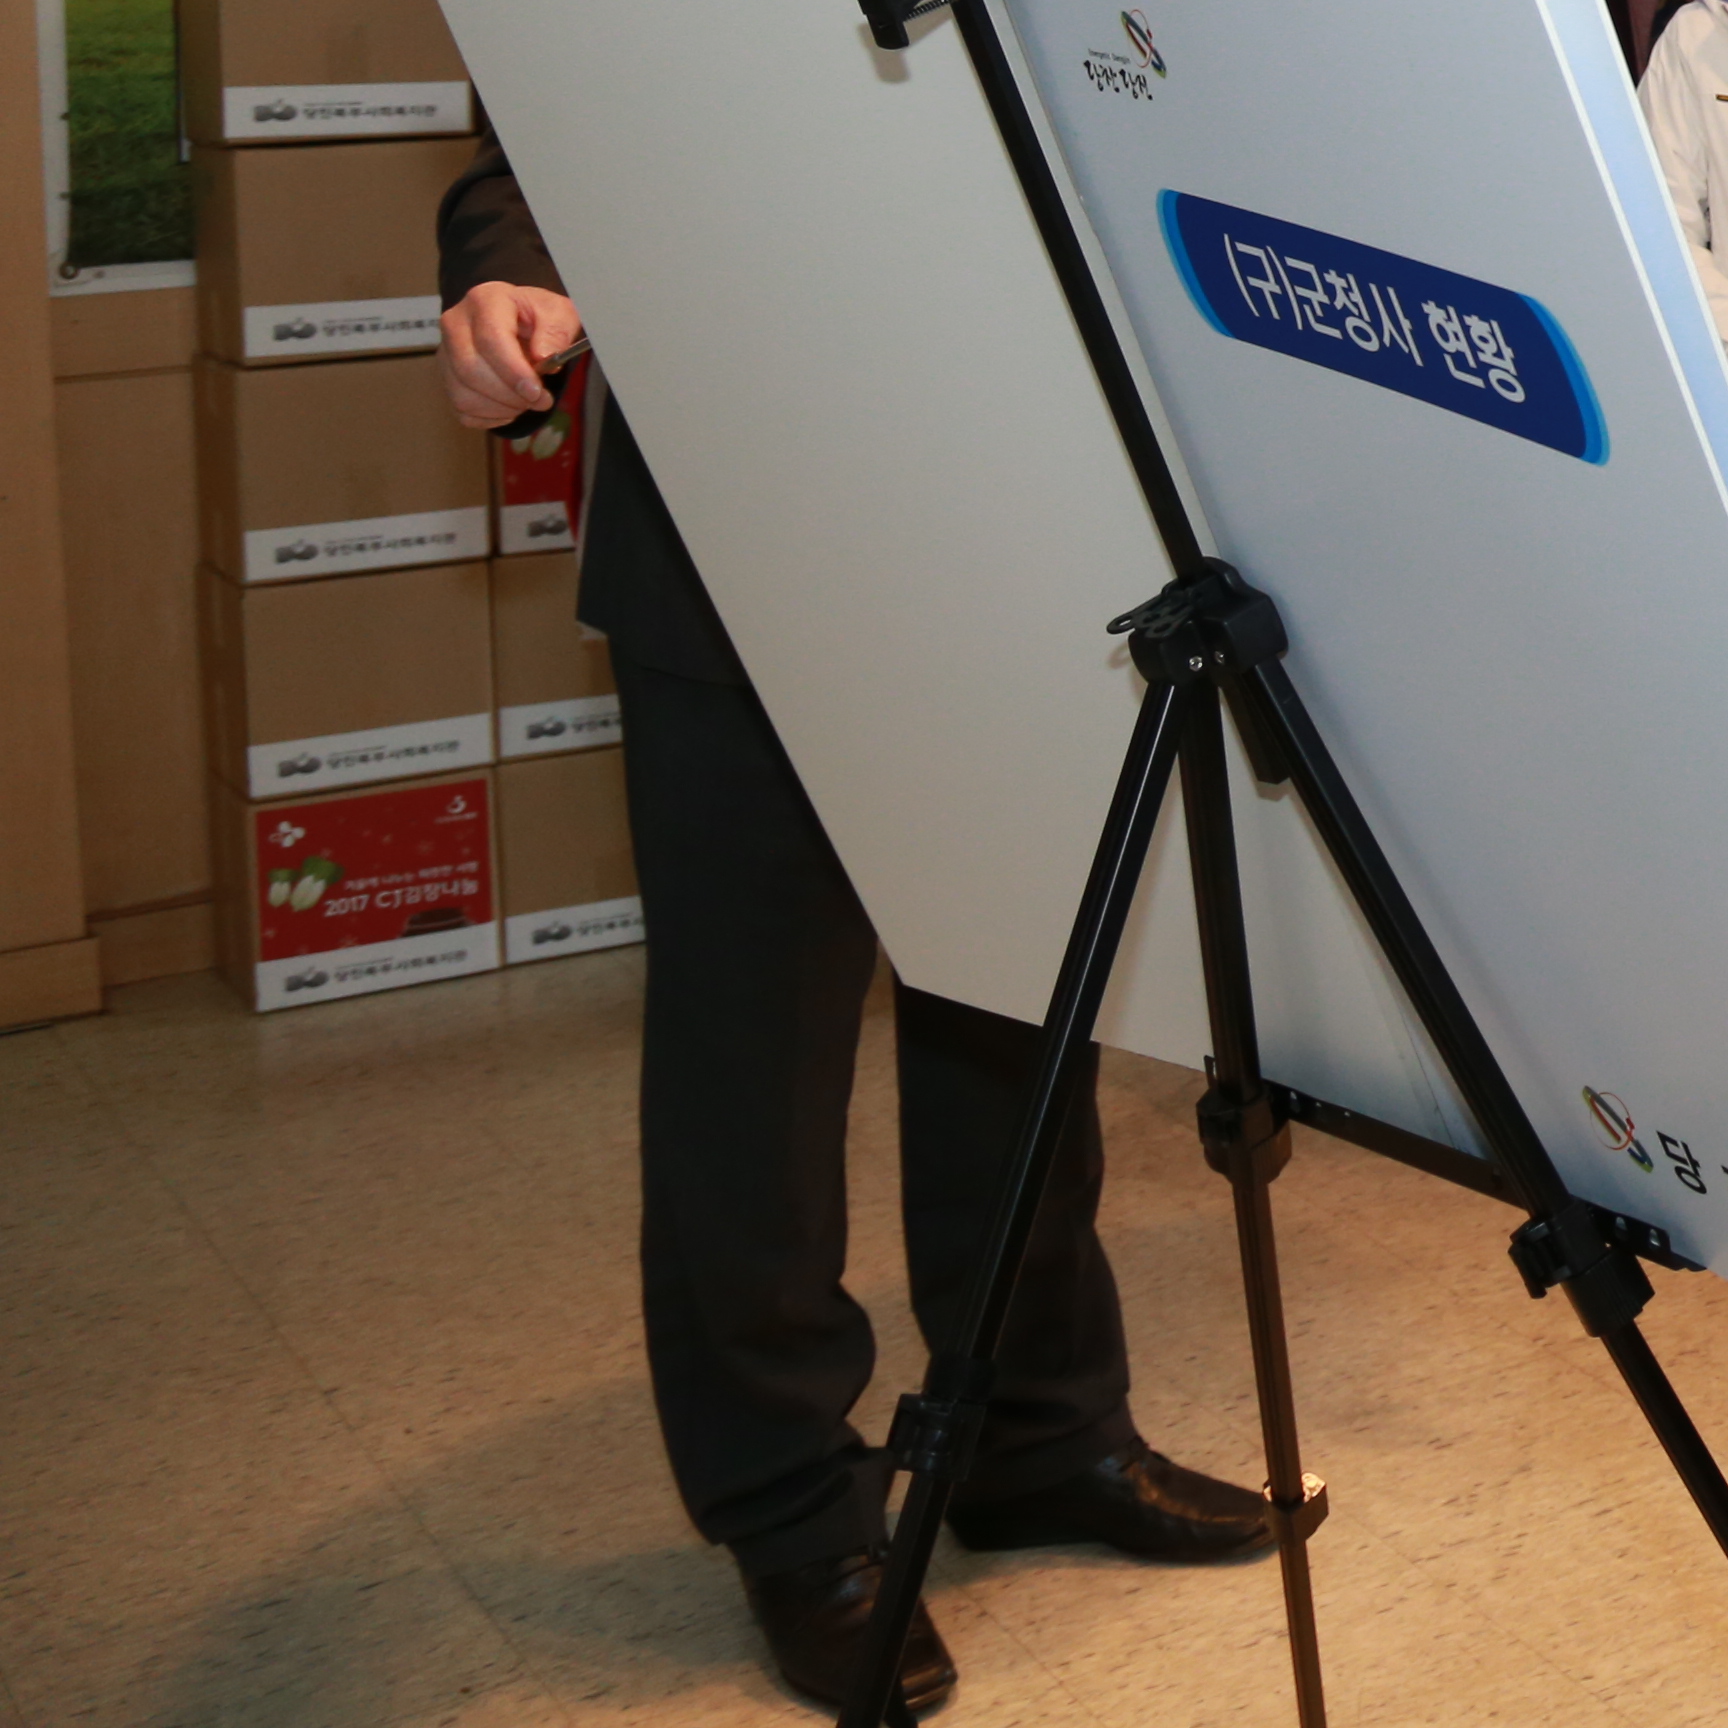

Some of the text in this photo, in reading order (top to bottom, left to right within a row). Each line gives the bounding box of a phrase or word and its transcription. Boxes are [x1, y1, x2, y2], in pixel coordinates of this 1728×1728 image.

[1223, 232, 1527, 404] (구)군청사 현황
[324, 894, 370, 917] 2017
